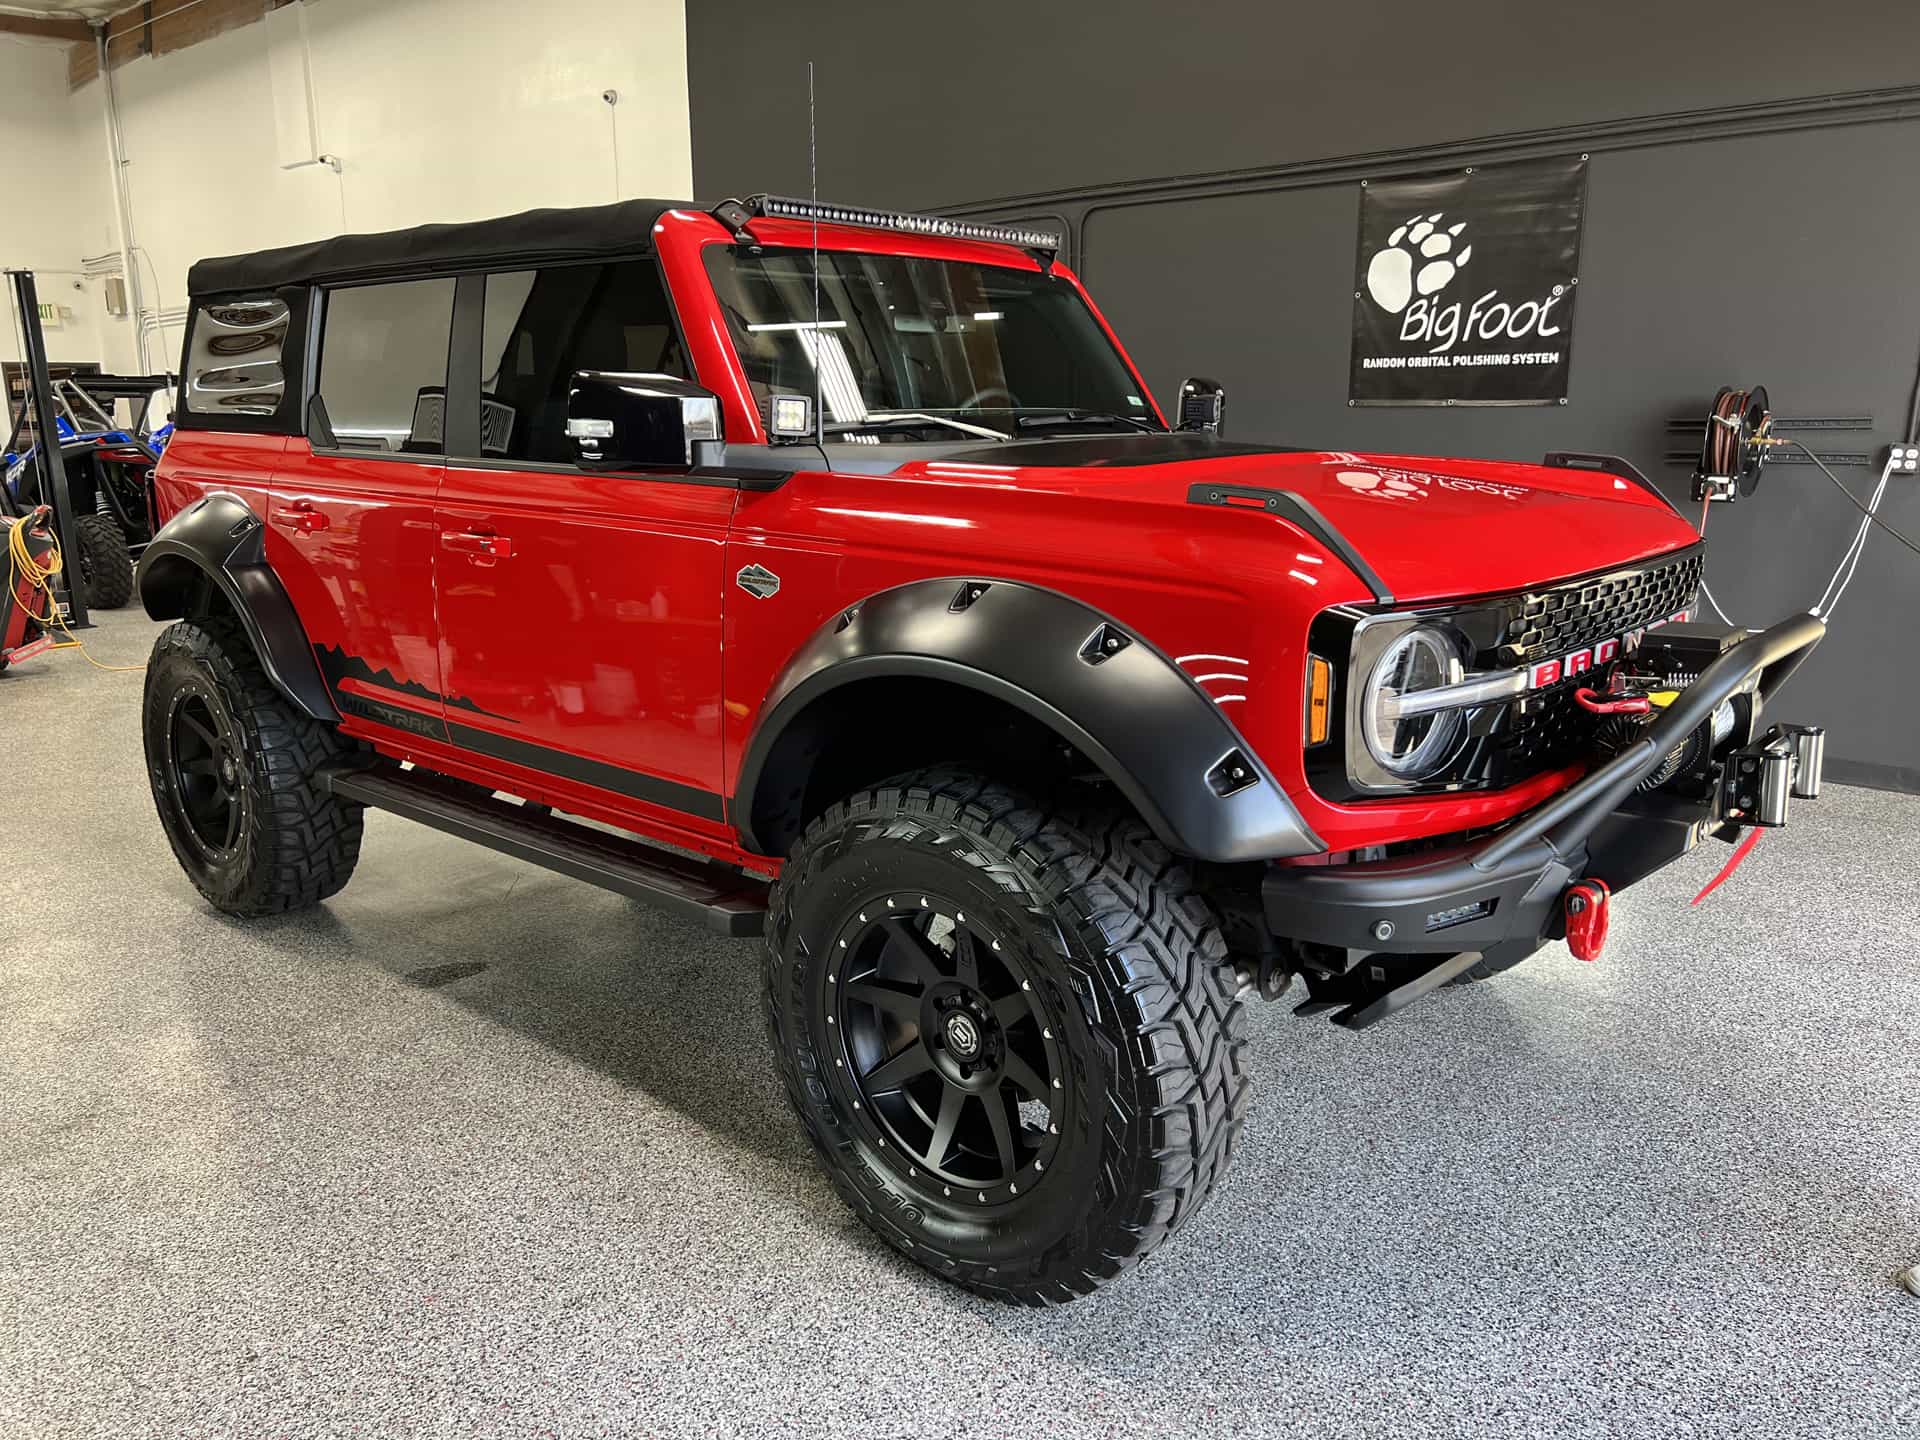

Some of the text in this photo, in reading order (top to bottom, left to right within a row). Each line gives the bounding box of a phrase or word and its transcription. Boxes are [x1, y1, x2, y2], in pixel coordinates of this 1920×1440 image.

[1363, 352, 1559, 368] RANDOM ORBITAL POLISHING SYSTEM
[1529, 610, 1690, 689] BRON
